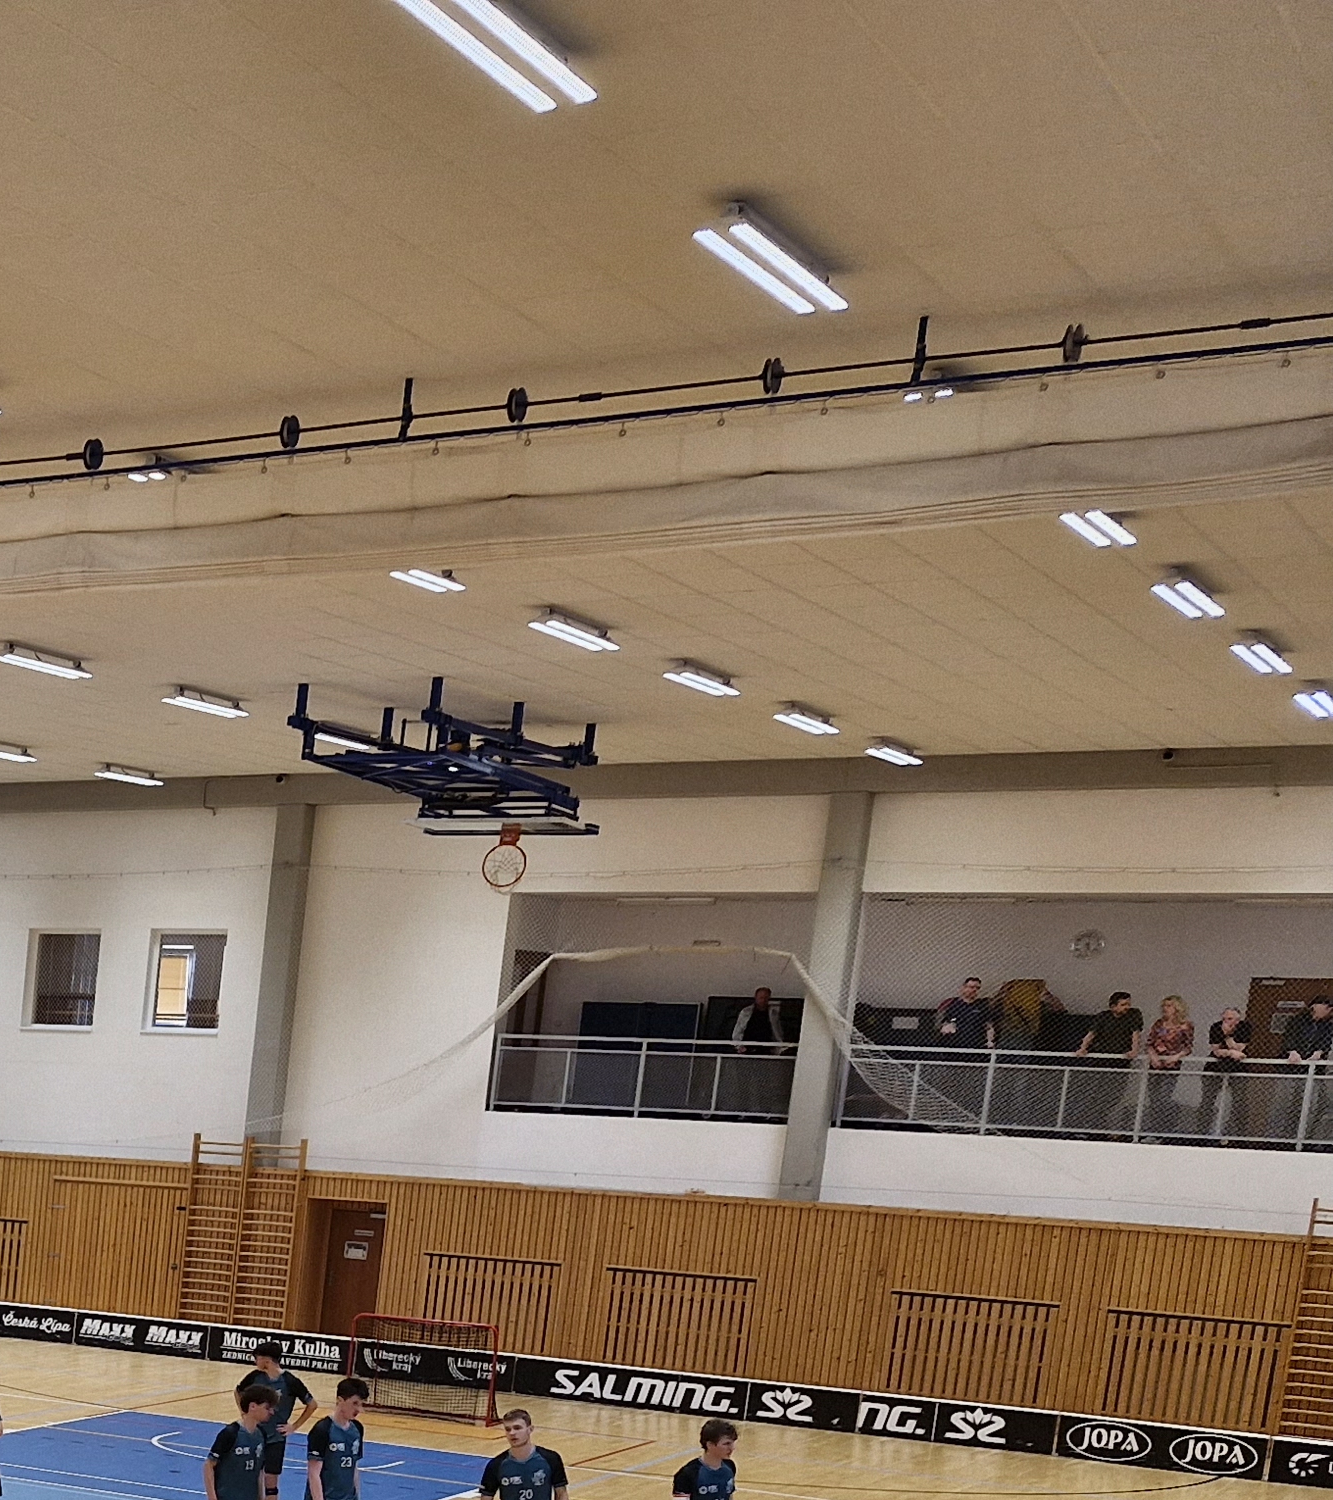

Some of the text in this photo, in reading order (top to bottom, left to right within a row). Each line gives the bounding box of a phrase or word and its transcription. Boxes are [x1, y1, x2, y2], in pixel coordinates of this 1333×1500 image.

[2, 1310, 72, 1333] Česká Lípa
[293, 1338, 341, 1359] Kulha
[373, 1348, 422, 1365] Liberecký
[311, 1359, 339, 1371] PRÁCE
[392, 1360, 412, 1374] kraj
[1081, 1426, 1140, 1453] JOPA
[1182, 1437, 1246, 1466] JOPA
[340, 1456, 352, 1468] 23
[518, 1488, 533, 1500] 20
